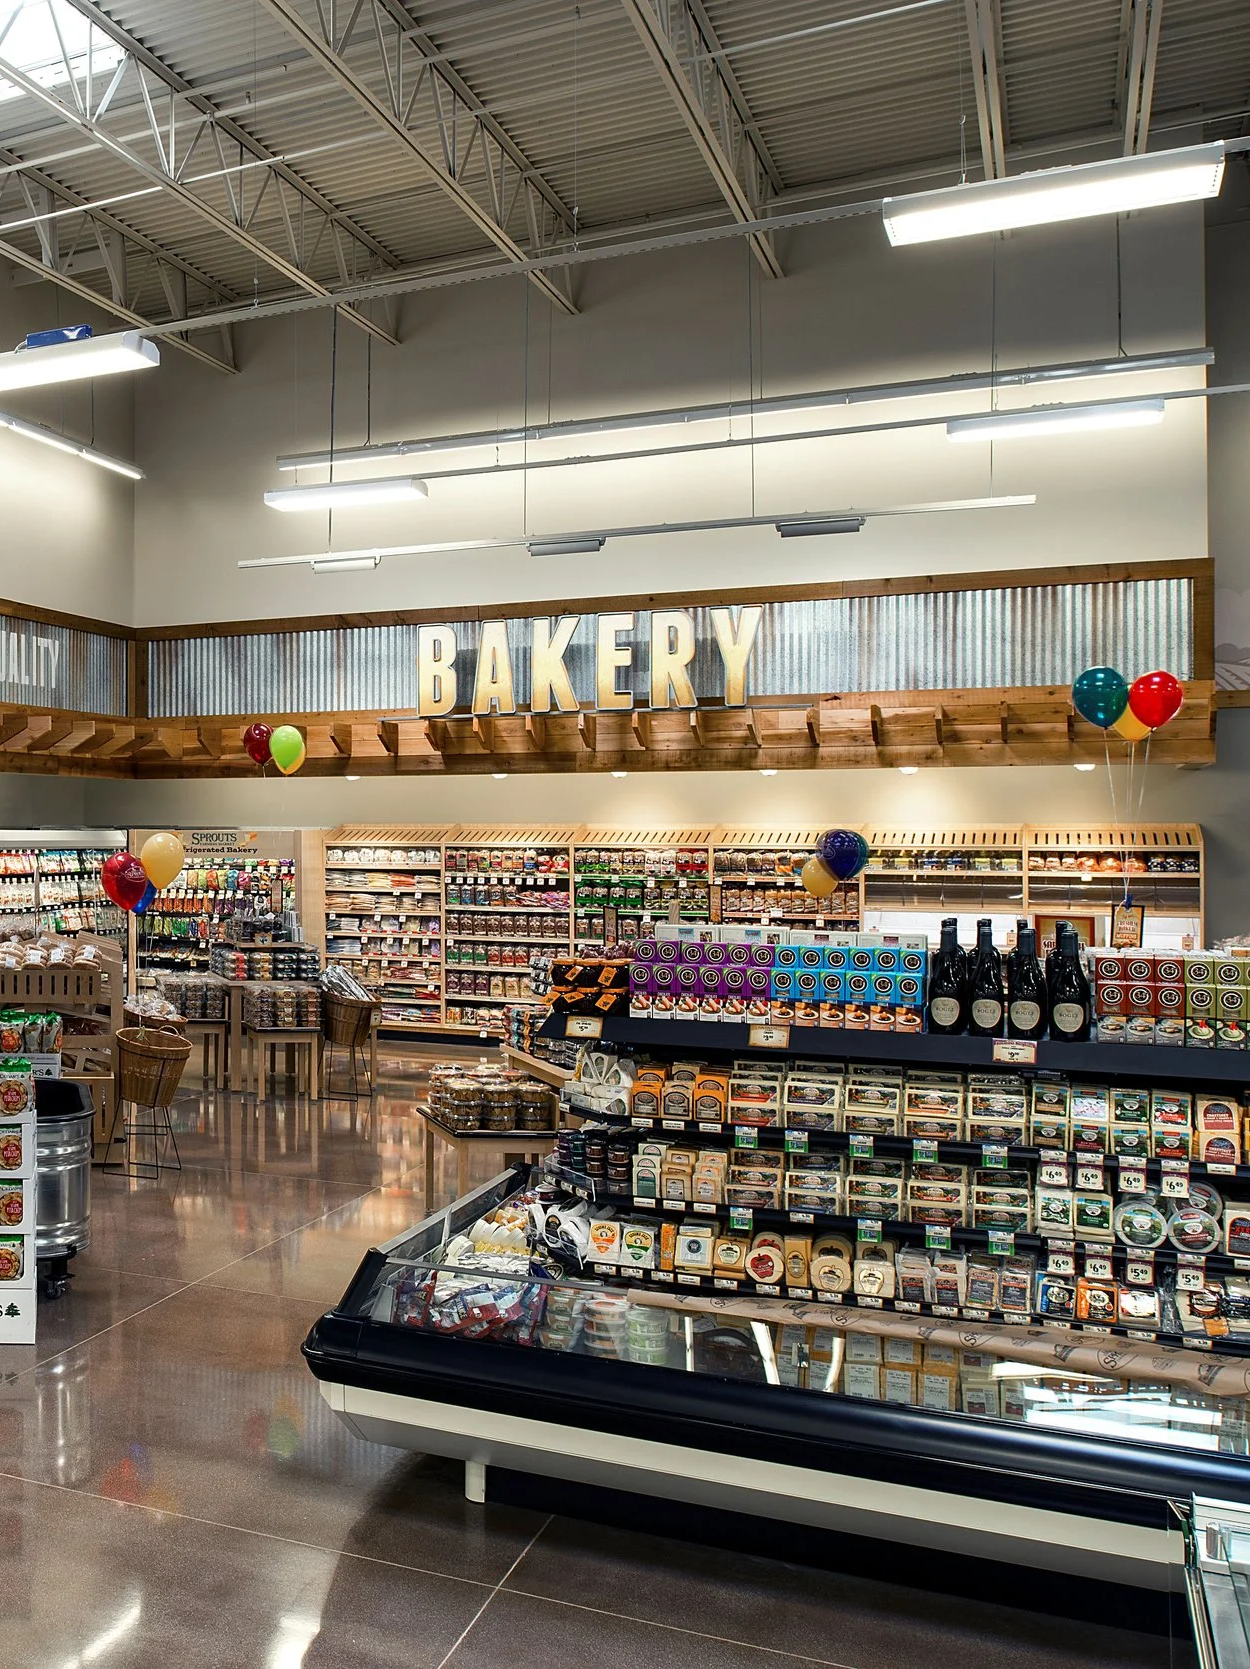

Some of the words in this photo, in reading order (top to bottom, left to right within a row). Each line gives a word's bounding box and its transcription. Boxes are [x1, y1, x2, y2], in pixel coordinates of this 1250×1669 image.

[416, 604, 764, 717] BAKERY
[191, 832, 237, 845] SPROUTS
[226, 846, 258, 854] Bakery
